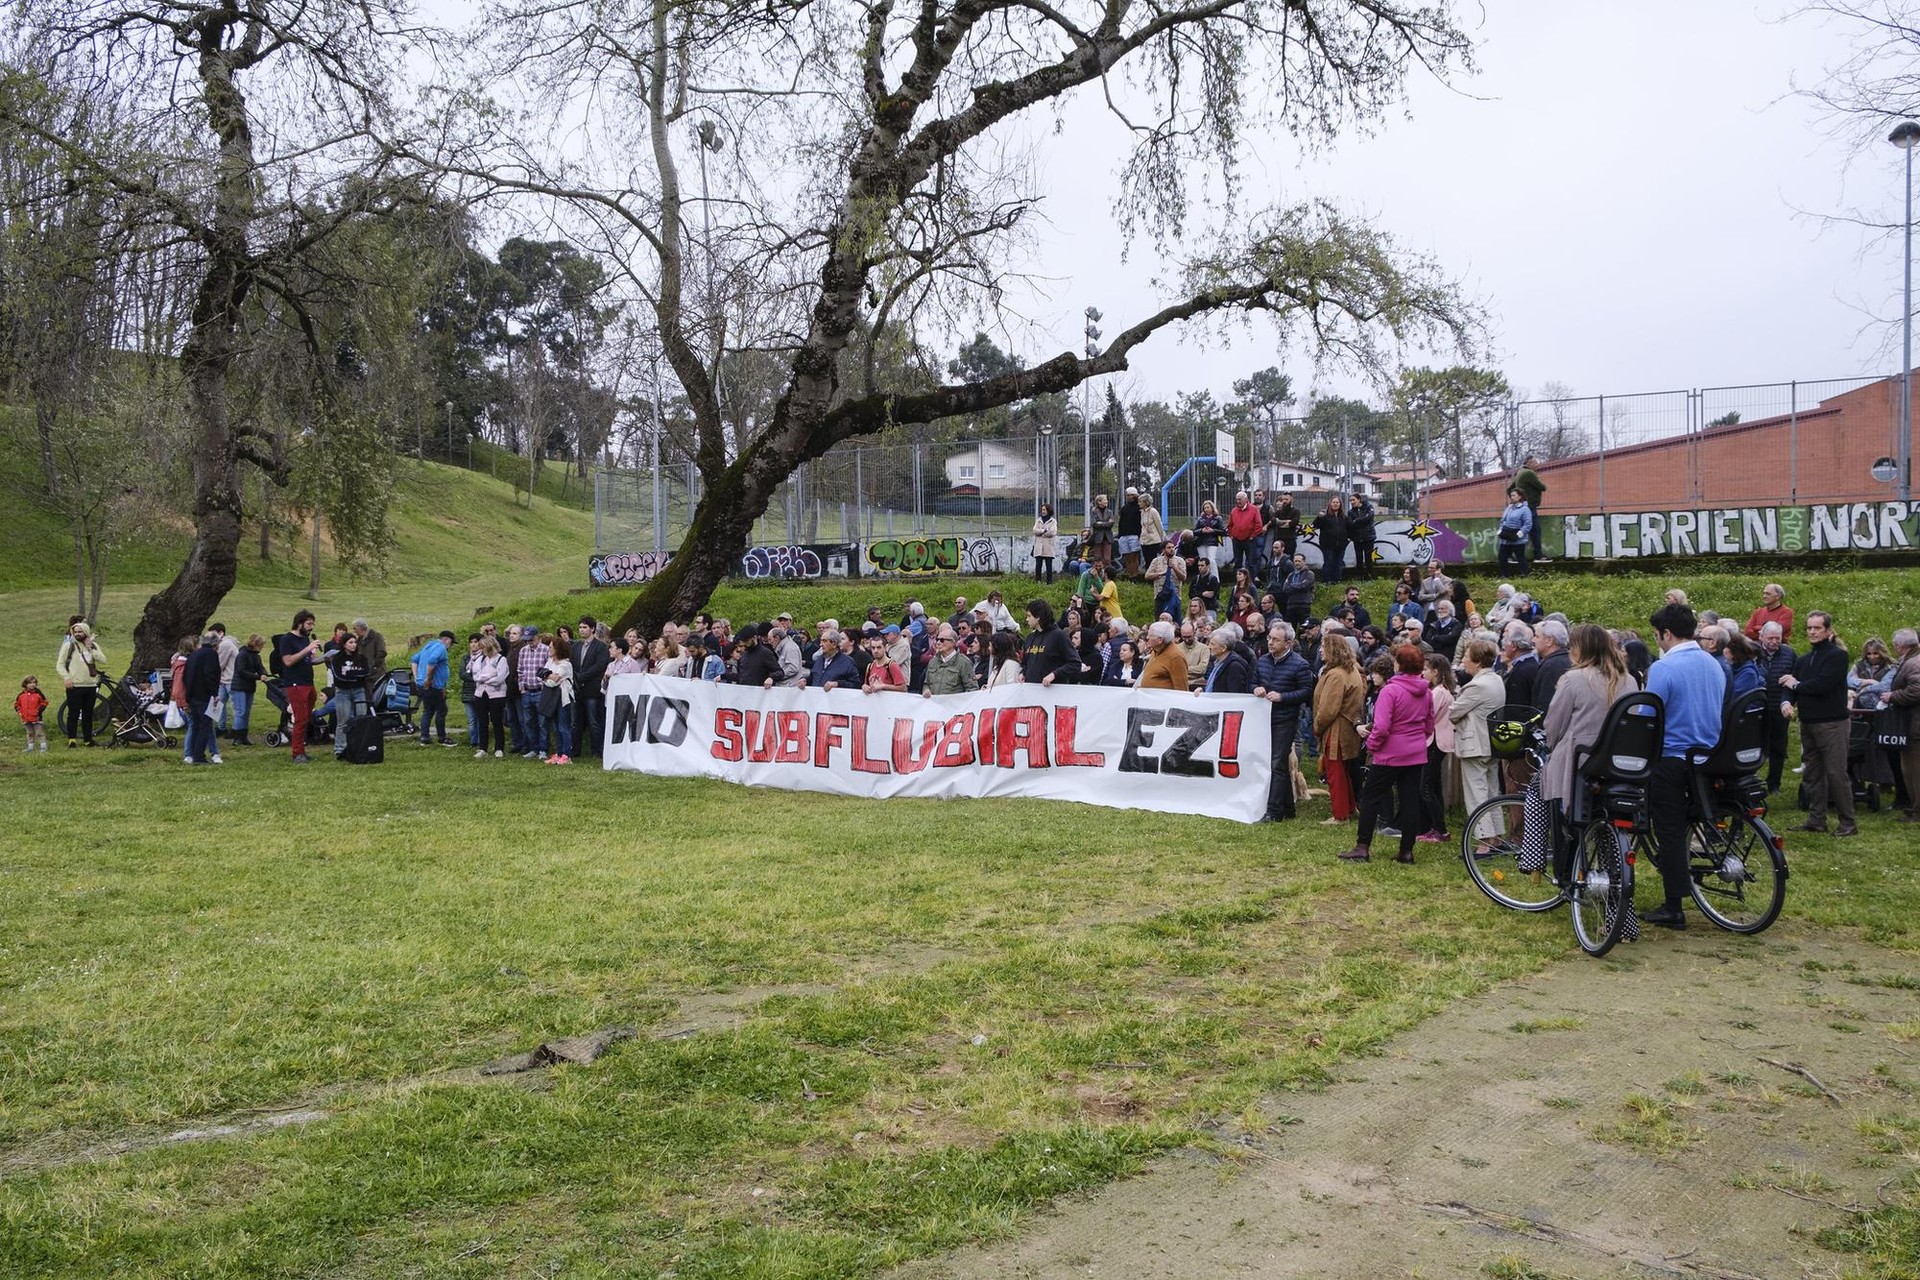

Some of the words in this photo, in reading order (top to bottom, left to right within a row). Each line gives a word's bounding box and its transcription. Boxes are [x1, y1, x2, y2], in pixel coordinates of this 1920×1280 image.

[1564, 508, 1778, 558] HERRIEN
[1810, 501, 1920, 550] NOR
[612, 694, 690, 747] NO
[710, 705, 1105, 775] SUBFLUBIAL
[1118, 707, 1244, 779] EZ!
[1878, 734, 1907, 746] ICON
